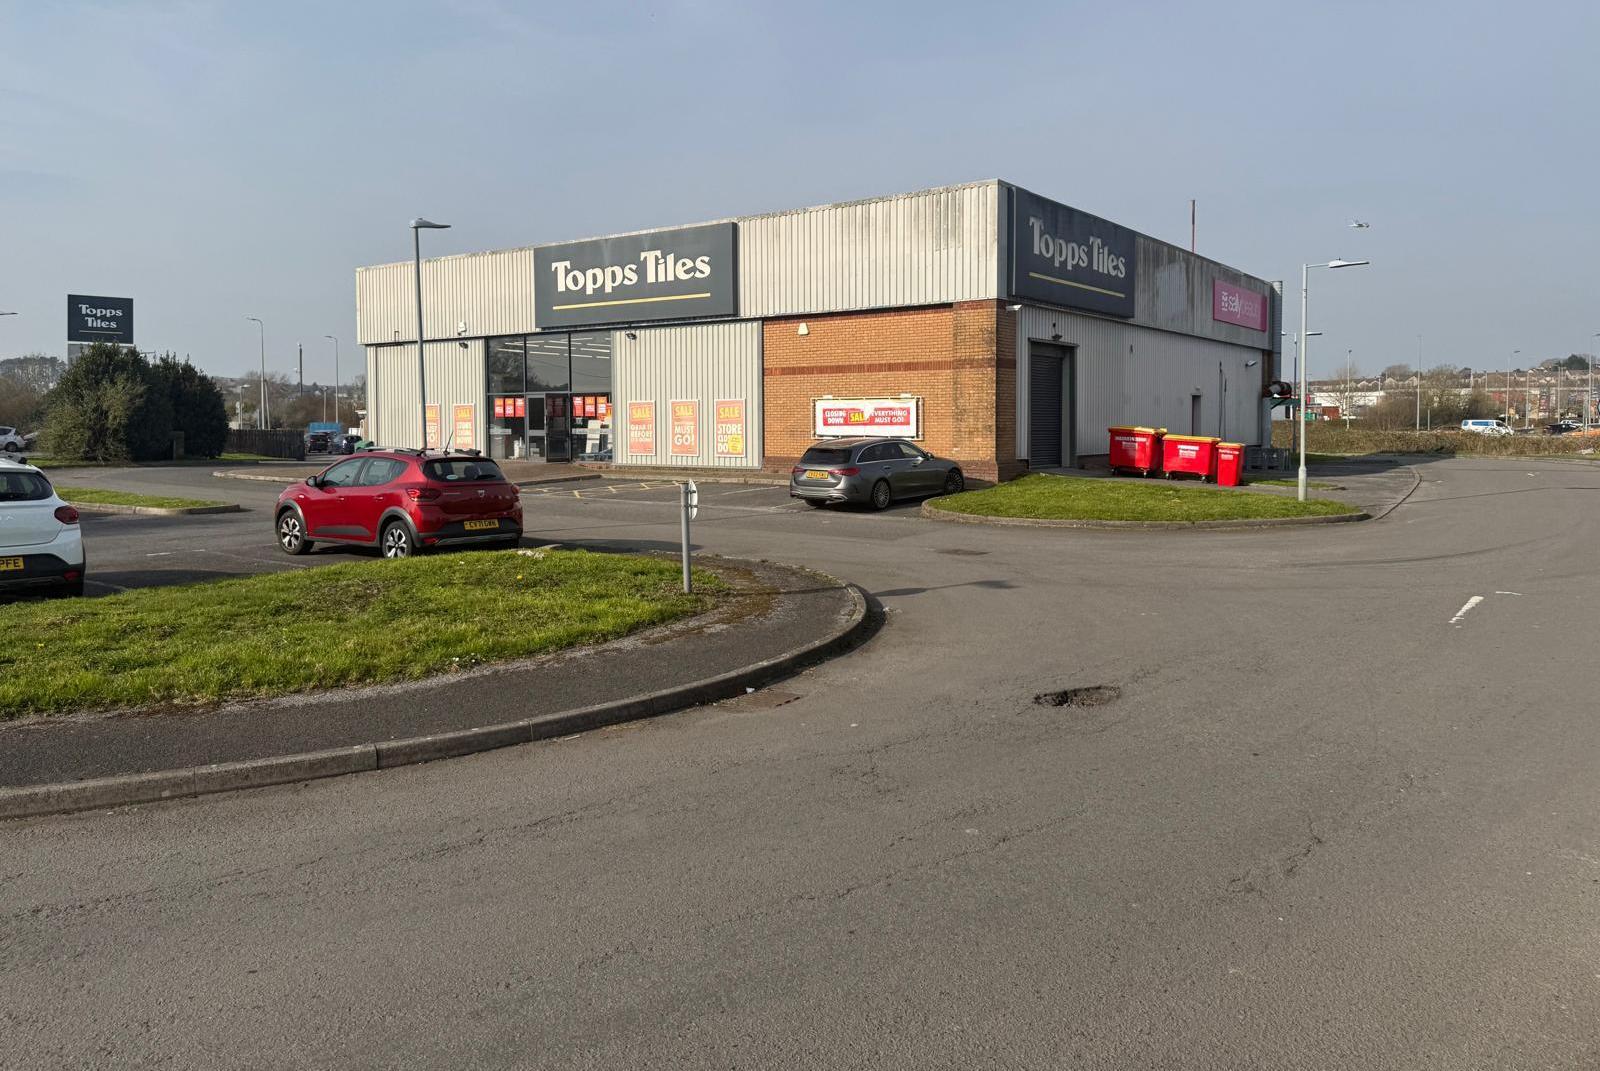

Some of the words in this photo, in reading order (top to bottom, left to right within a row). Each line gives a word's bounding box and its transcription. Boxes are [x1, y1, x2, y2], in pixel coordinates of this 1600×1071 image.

[1029, 216, 1088, 271] Topps
[1089, 236, 1126, 278] Tiles
[551, 260, 639, 295] Topps
[640, 250, 711, 284] Tiles
[78, 304, 123, 317] Topps
[85, 317, 117, 329] Tiles
[632, 407, 651, 419] SALE
[674, 405, 694, 417] SALE
[719, 407, 740, 419] SALE
[850, 411, 865, 422] SAL
[674, 425, 695, 434] MUST
[717, 423, 743, 434] STORE
[674, 434, 695, 446] GO!
